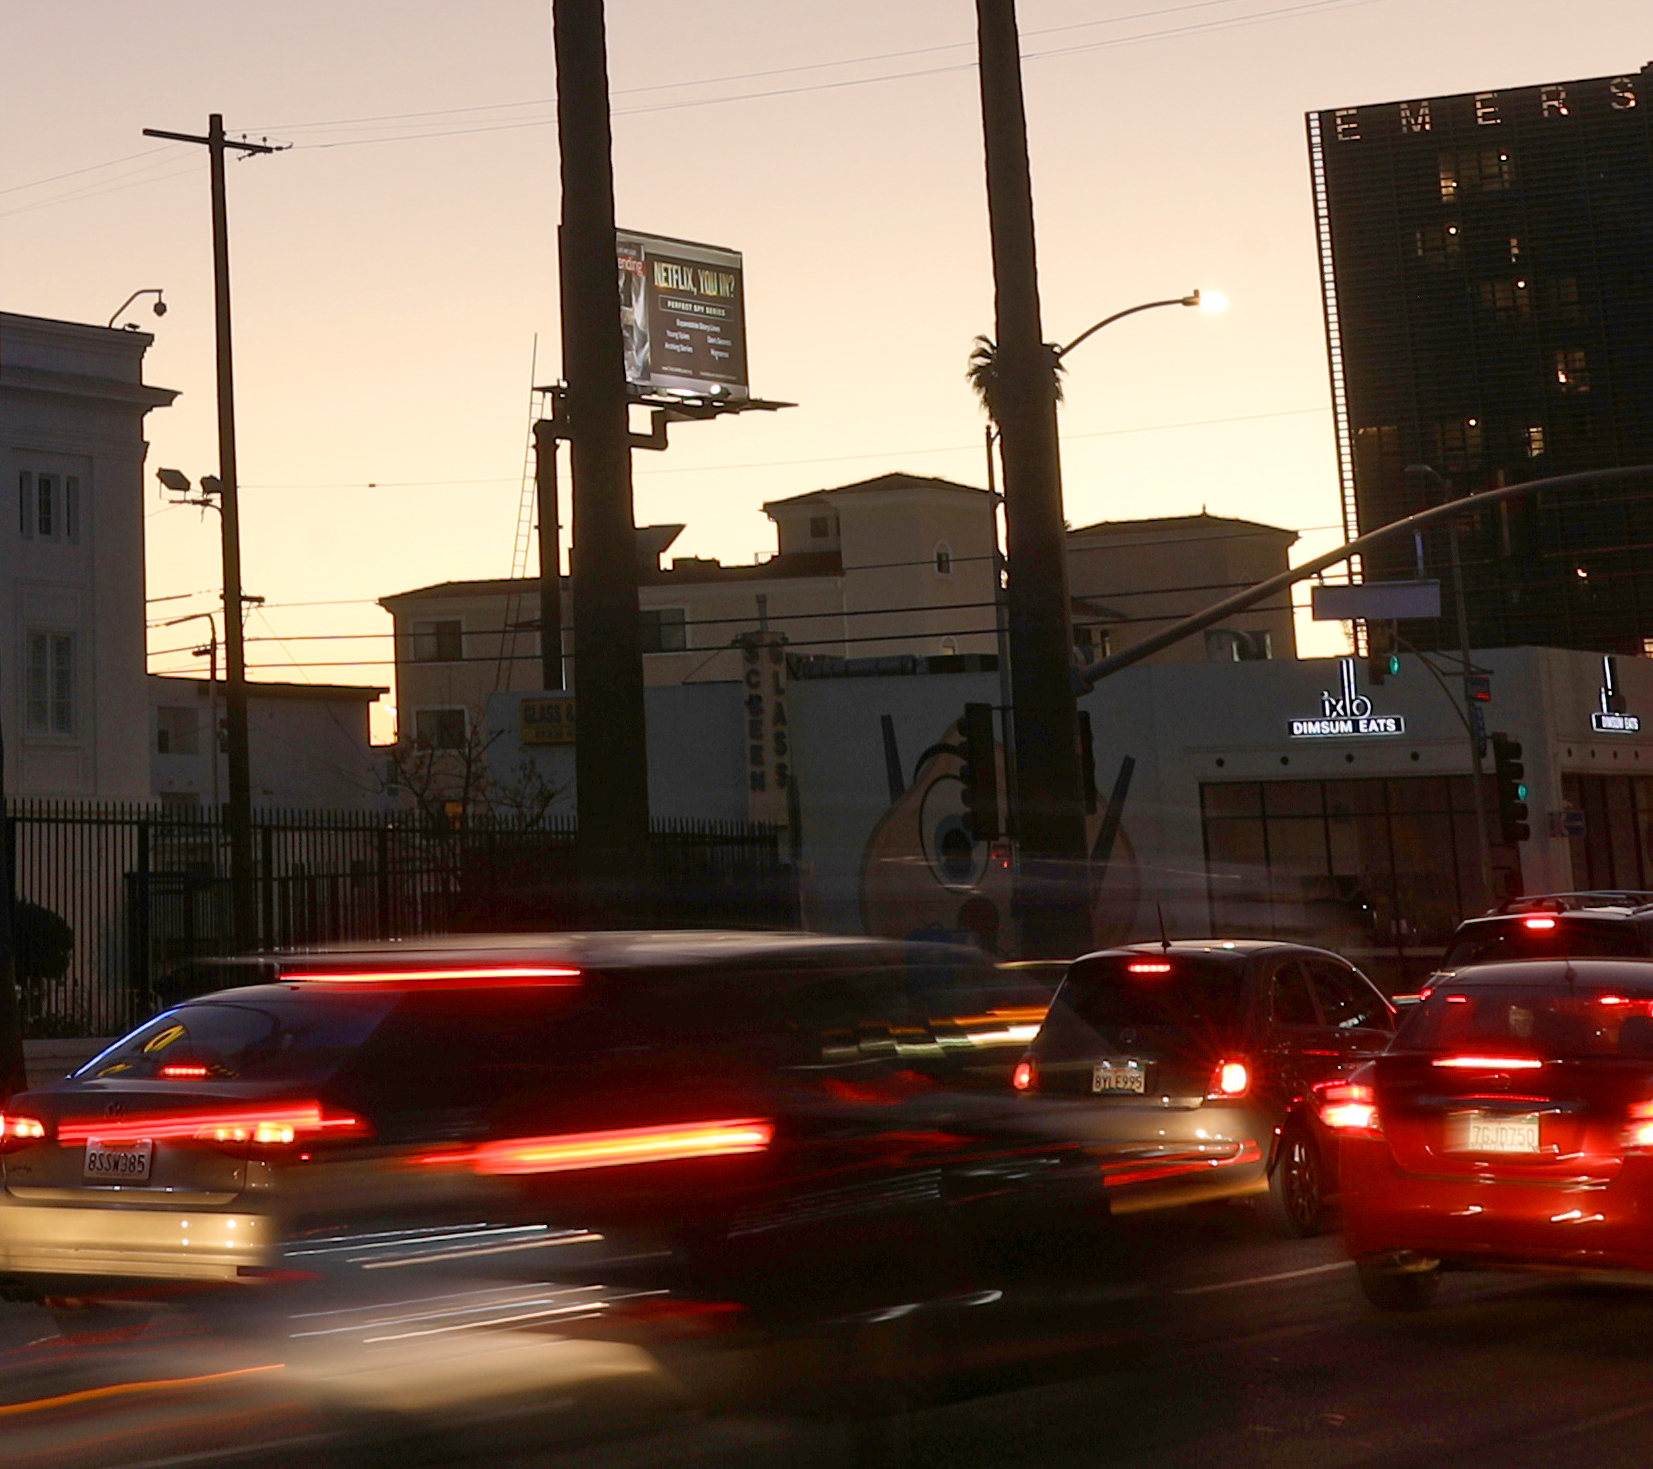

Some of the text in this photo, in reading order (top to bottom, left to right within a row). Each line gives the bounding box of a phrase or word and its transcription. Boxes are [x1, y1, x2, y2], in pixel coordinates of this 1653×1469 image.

[653, 261, 735, 298] NETFLIX, YOU IN?
[667, 300, 693, 313] PERFECT
[705, 307, 726, 317] SERIES
[1292, 717, 1397, 736] DIMSUM EATS
[88, 1152, 146, 1174] 8SSW385
